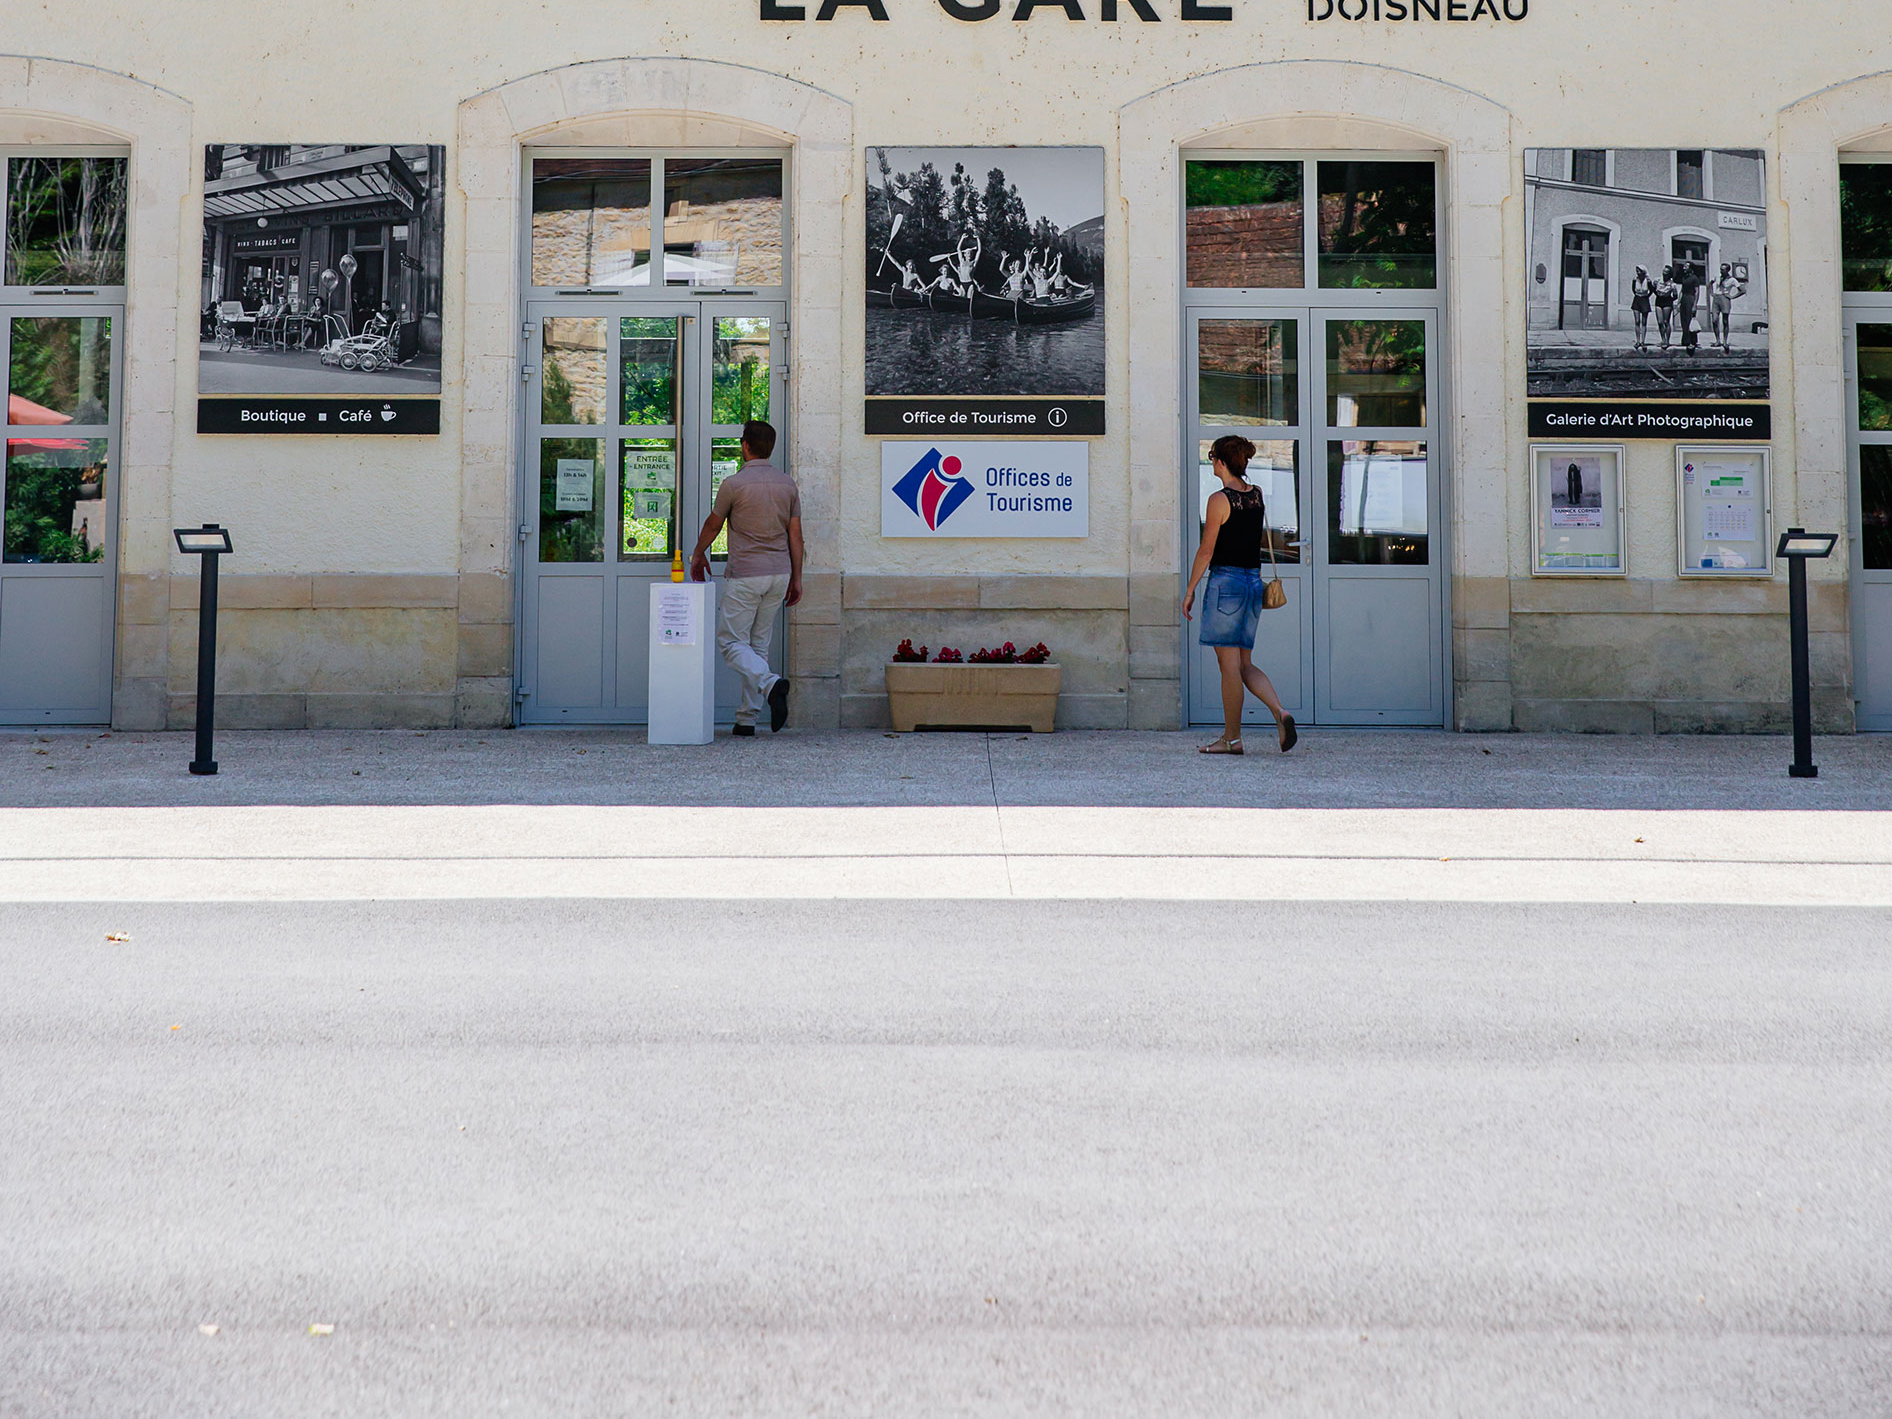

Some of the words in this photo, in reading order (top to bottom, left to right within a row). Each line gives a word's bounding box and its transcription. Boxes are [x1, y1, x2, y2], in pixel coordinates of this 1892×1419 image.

[1722, 215, 1754, 227] CARLUX
[241, 409, 306, 425] Boutique
[339, 409, 372, 423] Café
[902, 411, 946, 424] Office
[949, 411, 968, 424] de
[970, 411, 1037, 424] Tourisme
[1546, 413, 1596, 425] Galerie
[1599, 413, 1634, 426] d'Art
[1637, 413, 1754, 430] Photographique
[637, 455, 668, 463] ENTRÉE
[986, 467, 1051, 487] Offices
[1055, 471, 1073, 487] de
[986, 492, 1073, 512] Tourisme
